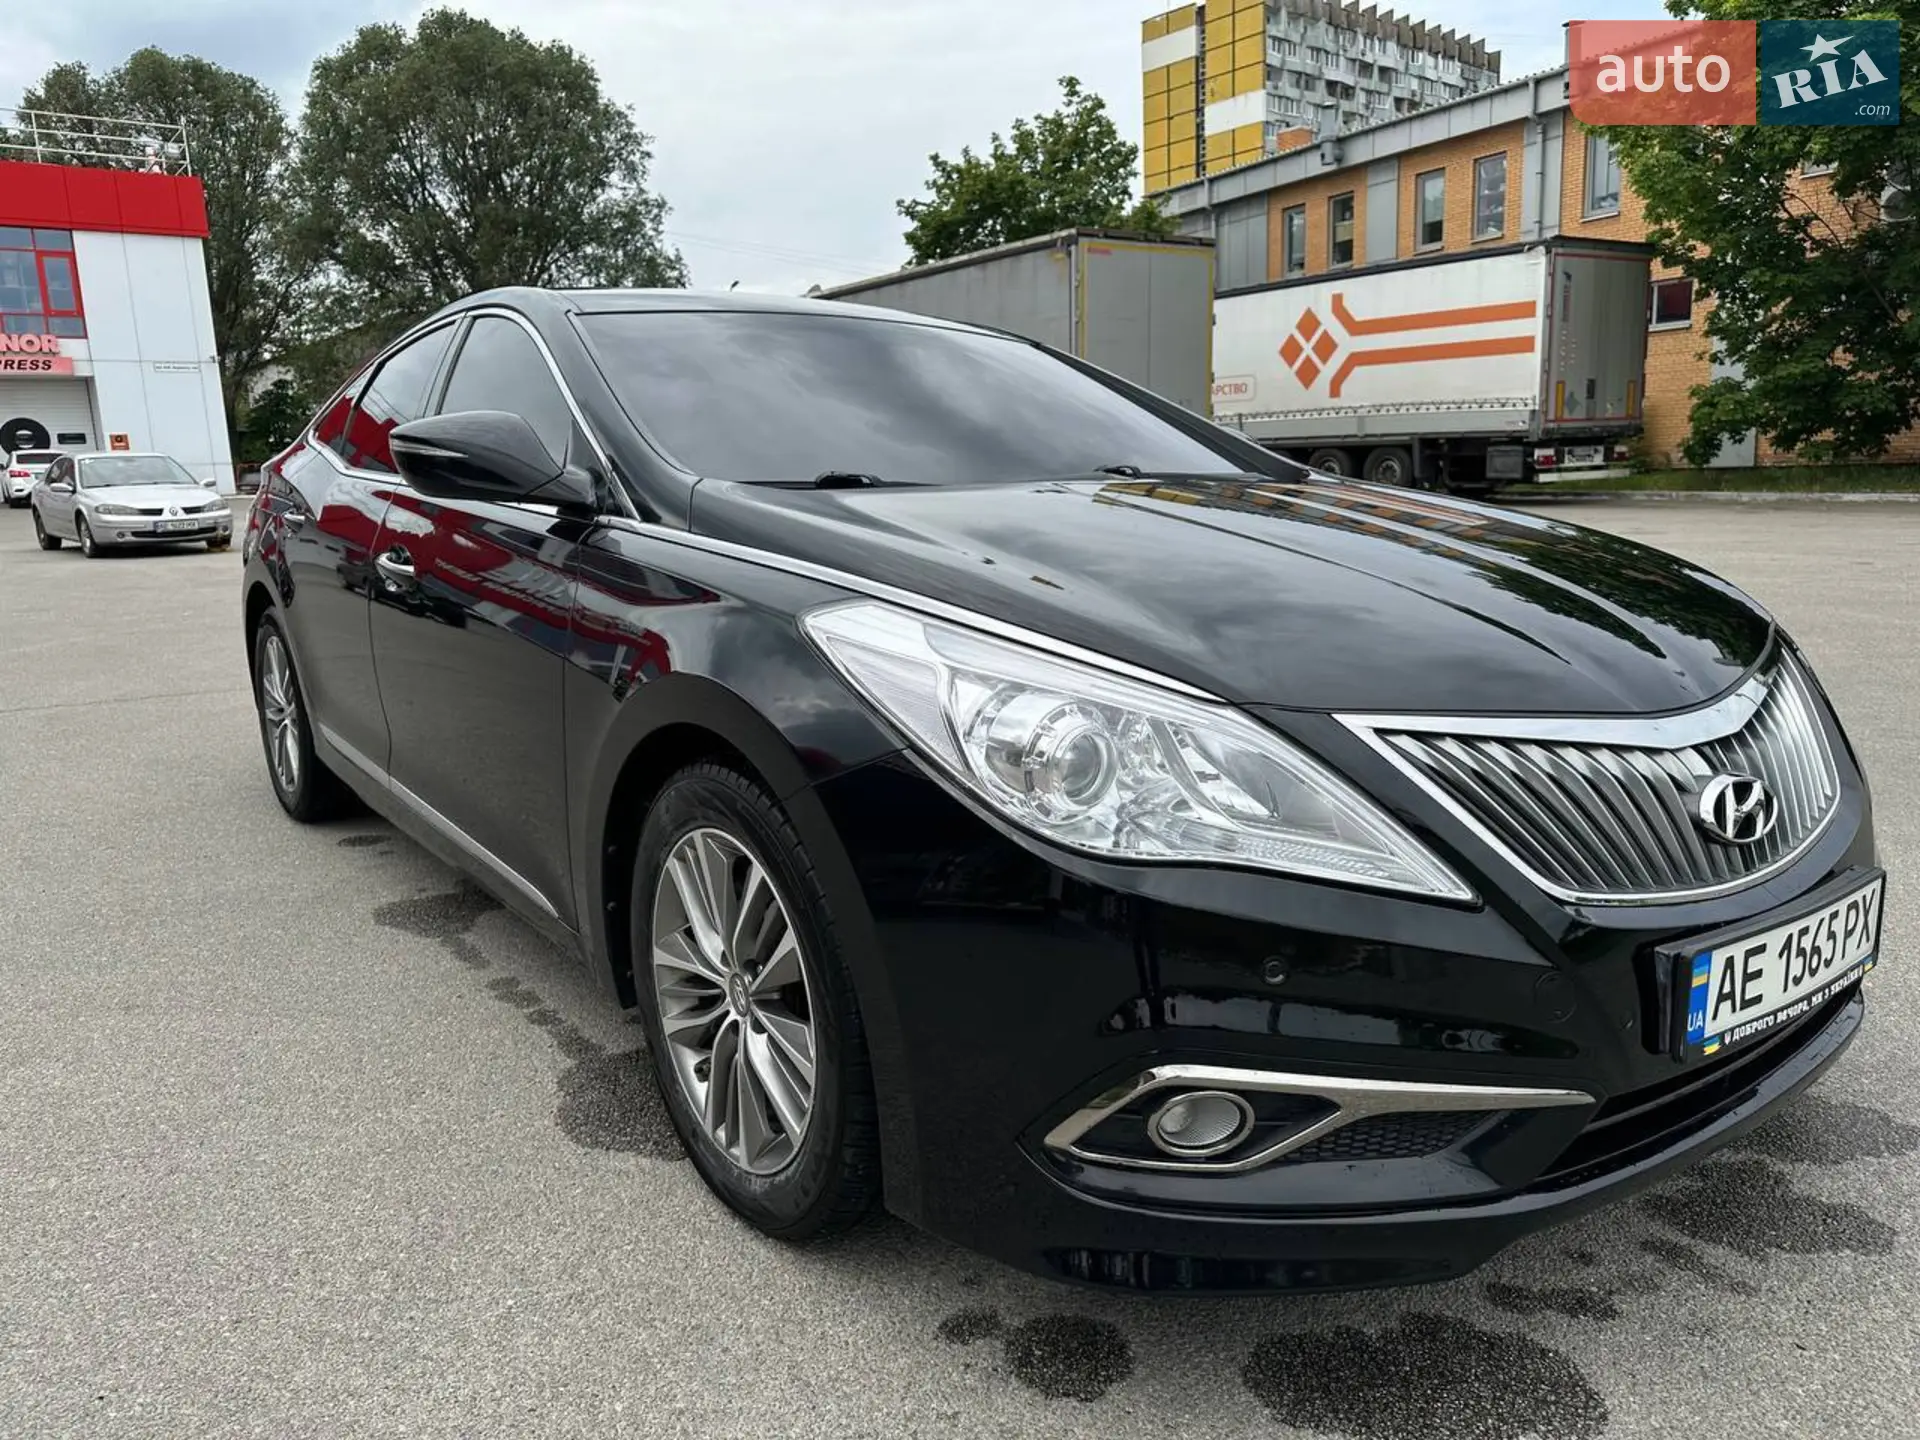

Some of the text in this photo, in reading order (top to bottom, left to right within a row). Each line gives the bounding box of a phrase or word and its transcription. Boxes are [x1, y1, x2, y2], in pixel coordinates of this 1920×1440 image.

[0, 359, 53, 371] RESS
[1712, 943, 1768, 1021] AE
[1687, 1012, 1704, 1032] UA
[1732, 1015, 1775, 1042] ДОБРОГО
